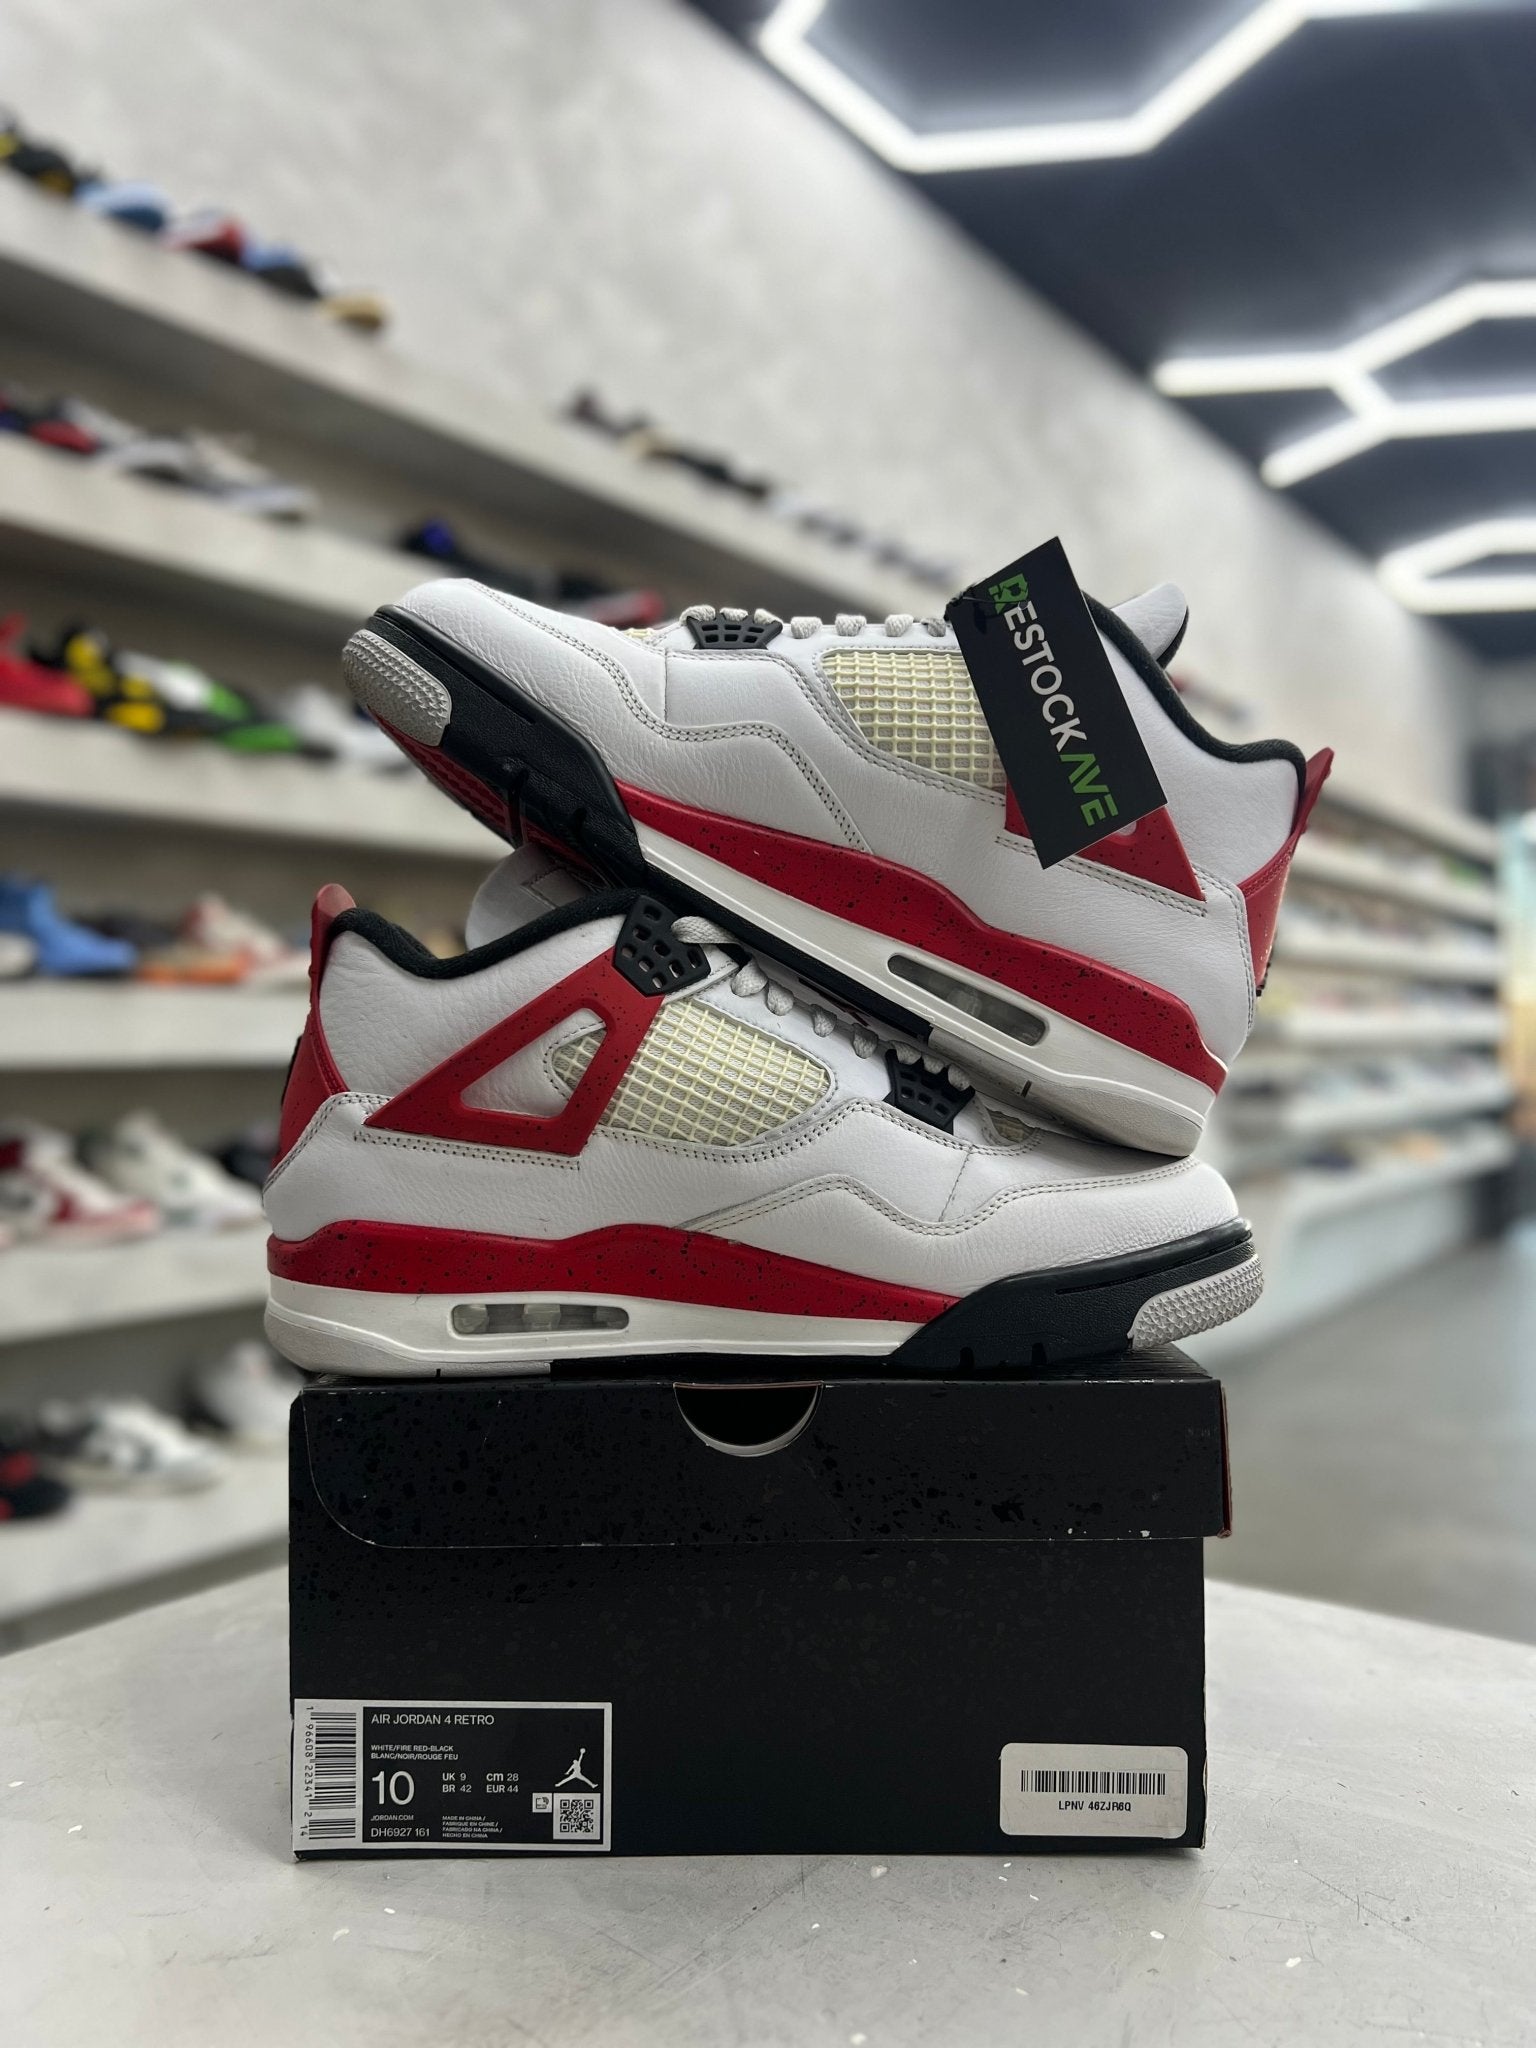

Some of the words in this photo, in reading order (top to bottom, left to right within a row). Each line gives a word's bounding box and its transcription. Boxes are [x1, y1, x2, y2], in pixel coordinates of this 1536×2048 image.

[371, 1714, 390, 1724] AIR
[393, 1714, 441, 1725] JORDAN
[444, 1715, 451, 1725] 4
[454, 1715, 495, 1725] RETRO
[305, 1724, 314, 1757] 96608
[304, 1765, 313, 1798] 22341
[442, 1773, 455, 1781] UK
[460, 1773, 467, 1781] 9
[486, 1773, 504, 1782] cm
[507, 1773, 519, 1782] 28
[371, 1771, 415, 1806] 10
[442, 1784, 456, 1793] BR
[460, 1784, 472, 1793] 42
[486, 1785, 505, 1793] EUR
[507, 1785, 519, 1793] 44
[1058, 1801, 1084, 1811] LPNV
[1088, 1801, 1132, 1812] 46ZJR6Q
[371, 1828, 412, 1837] DH6927
[415, 1828, 430, 1837] 161
